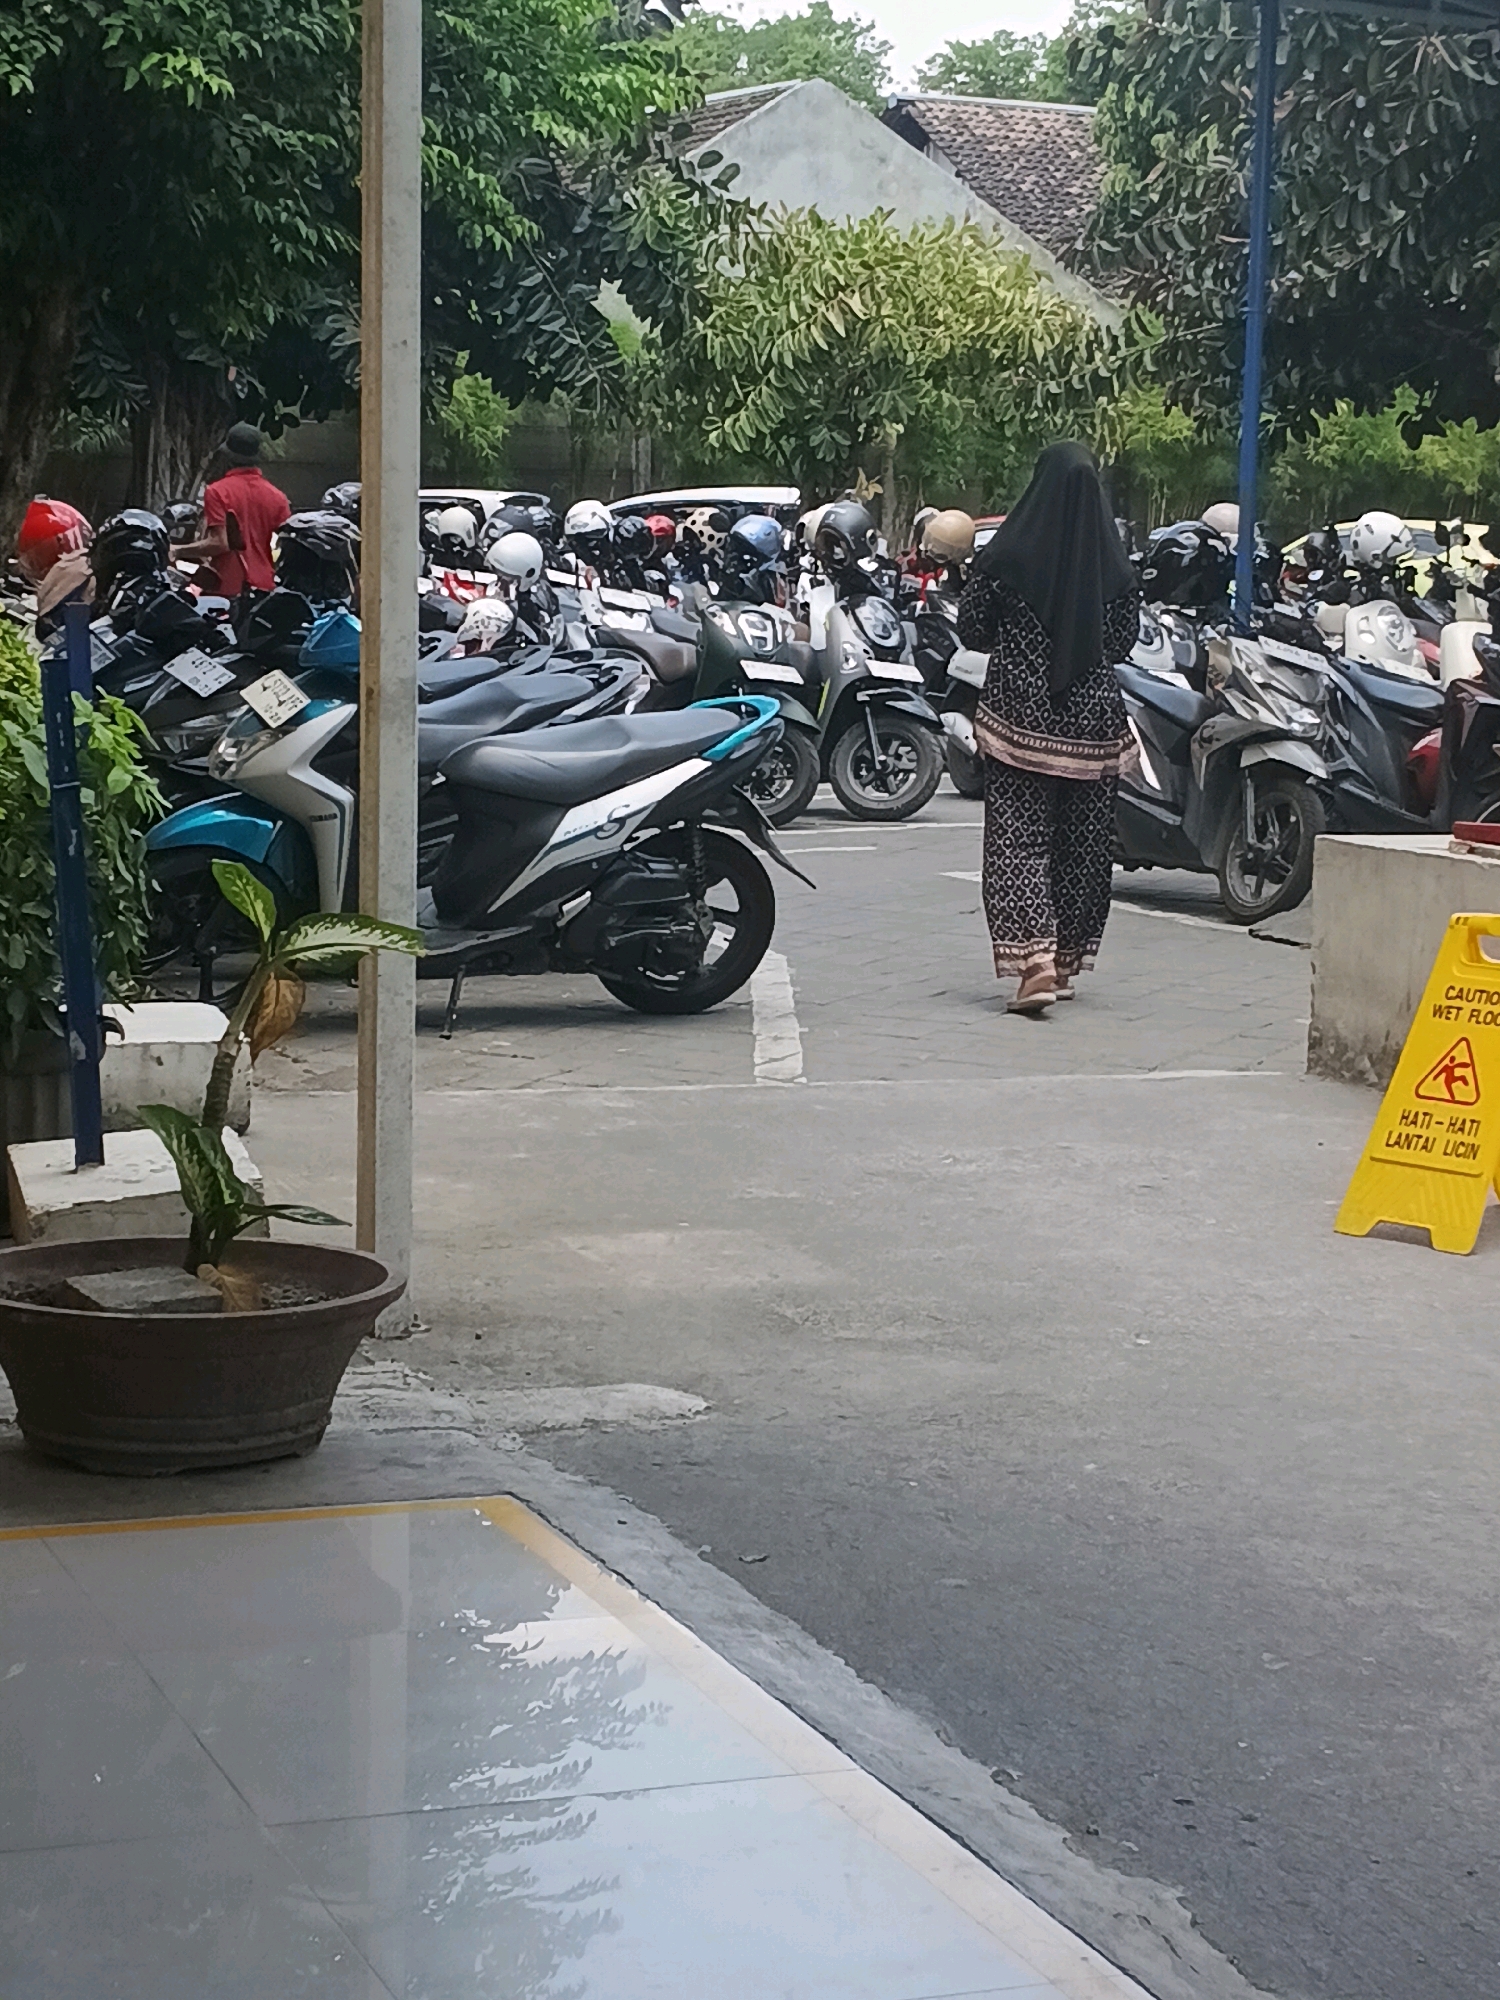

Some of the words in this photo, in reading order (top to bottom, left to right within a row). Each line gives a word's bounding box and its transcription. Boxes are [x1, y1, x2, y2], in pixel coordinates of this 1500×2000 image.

[1432, 1003, 1464, 1022] WET
[1385, 1130, 1437, 1153] LANTAI
[1442, 1139, 1480, 1160] LICIN
